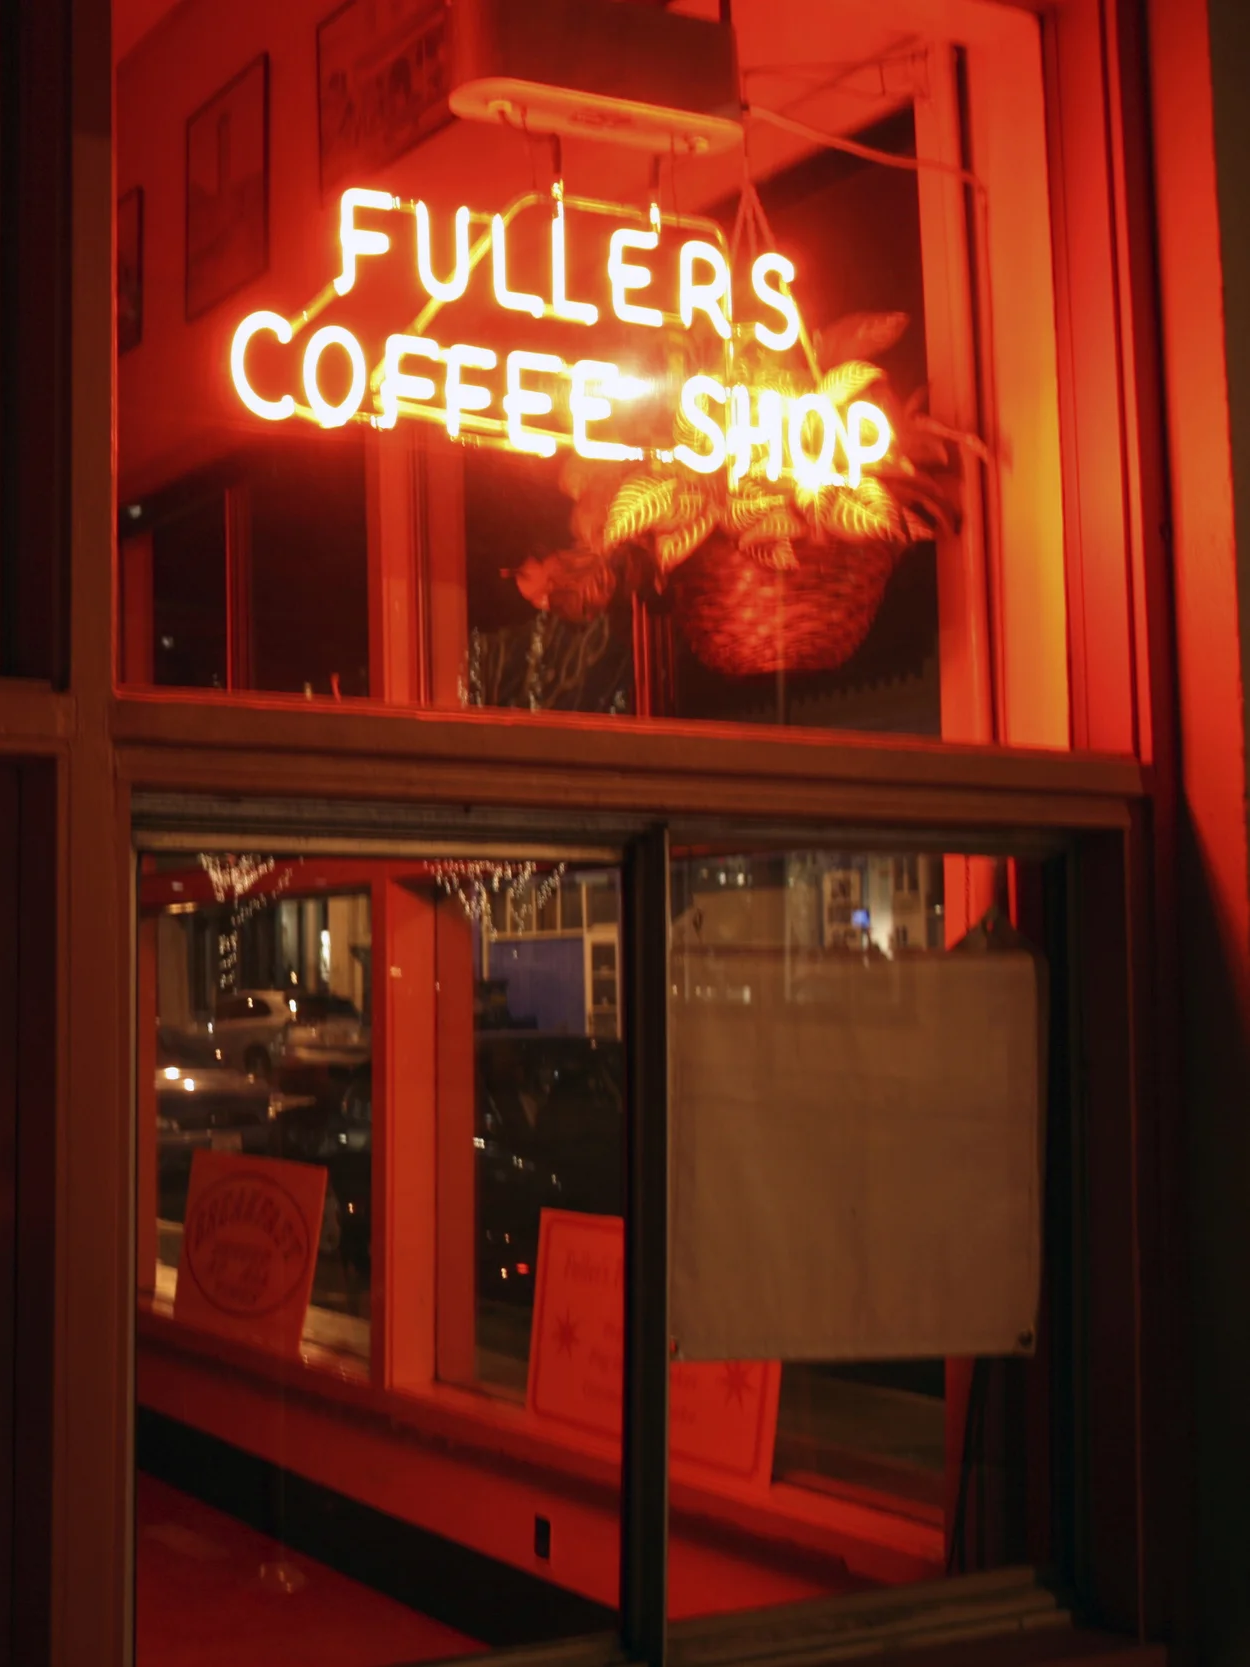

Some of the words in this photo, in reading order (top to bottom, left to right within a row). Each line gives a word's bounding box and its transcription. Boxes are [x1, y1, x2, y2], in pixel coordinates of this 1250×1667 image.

[334, 186, 803, 352] FULLERS
[230, 309, 633, 460] COFFEE
[676, 374, 892, 490] SHOP
